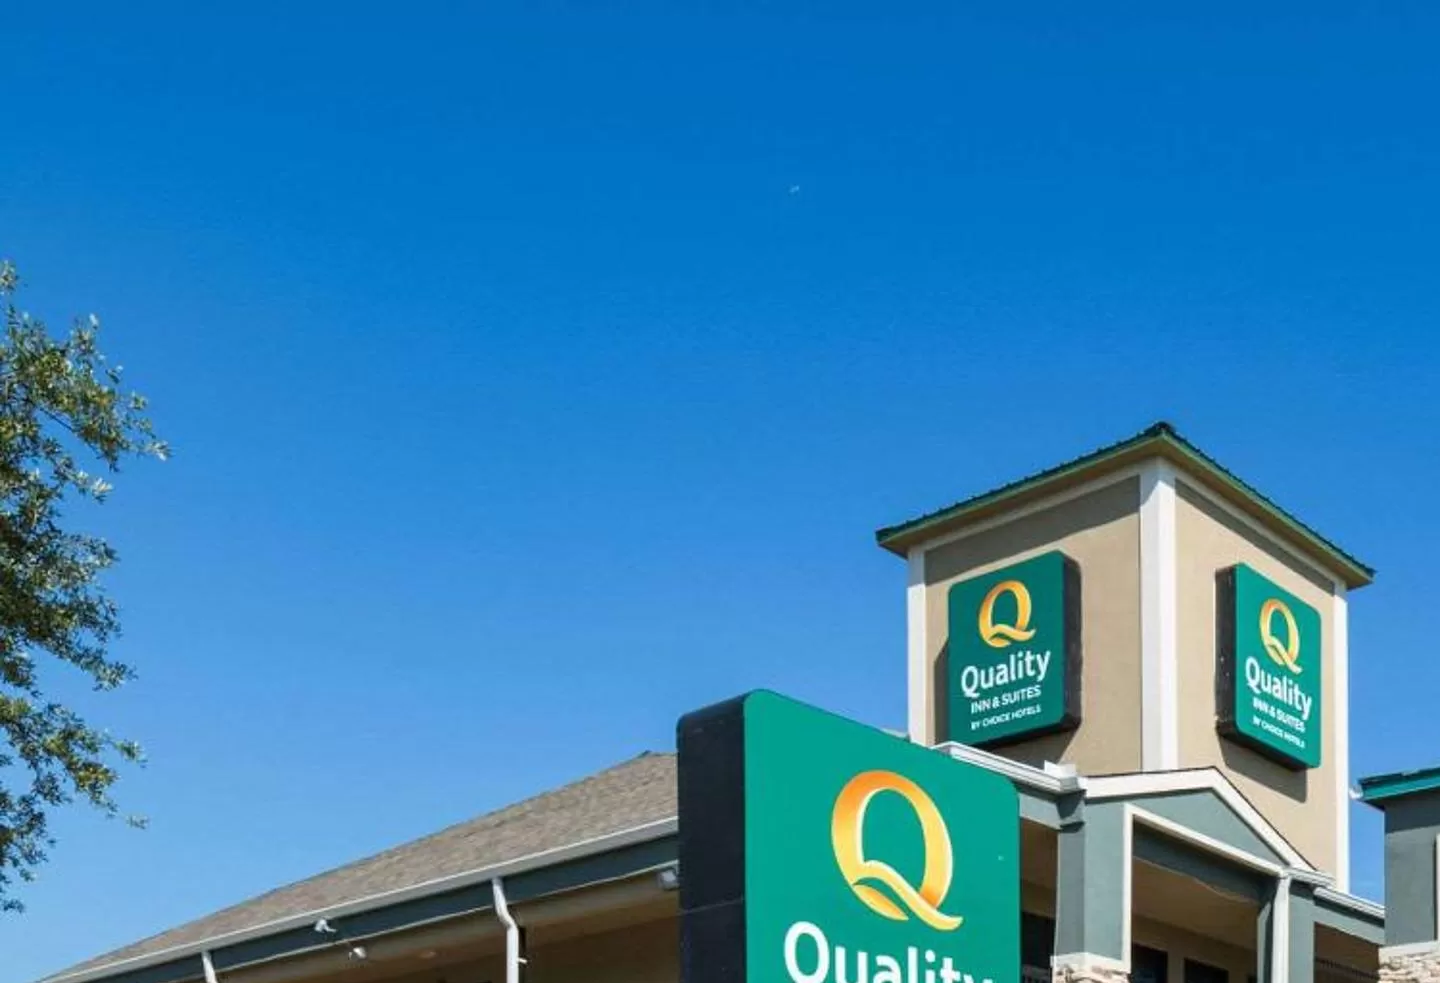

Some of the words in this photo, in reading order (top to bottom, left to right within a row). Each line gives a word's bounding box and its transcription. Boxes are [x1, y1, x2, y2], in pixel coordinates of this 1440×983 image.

[960, 649, 1051, 698] Quality
[1245, 655, 1312, 720] Quality
[970, 698, 991, 714] INN
[992, 695, 1001, 708] &
[1002, 685, 1041, 706] SUITES
[1252, 697, 1269, 714] INN
[1277, 709, 1305, 733] SUITES
[970, 719, 981, 731] BY
[982, 711, 1011, 728] CHOICE
[1011, 704, 1042, 720] HOTELS
[1262, 720, 1284, 739] CHOICE
